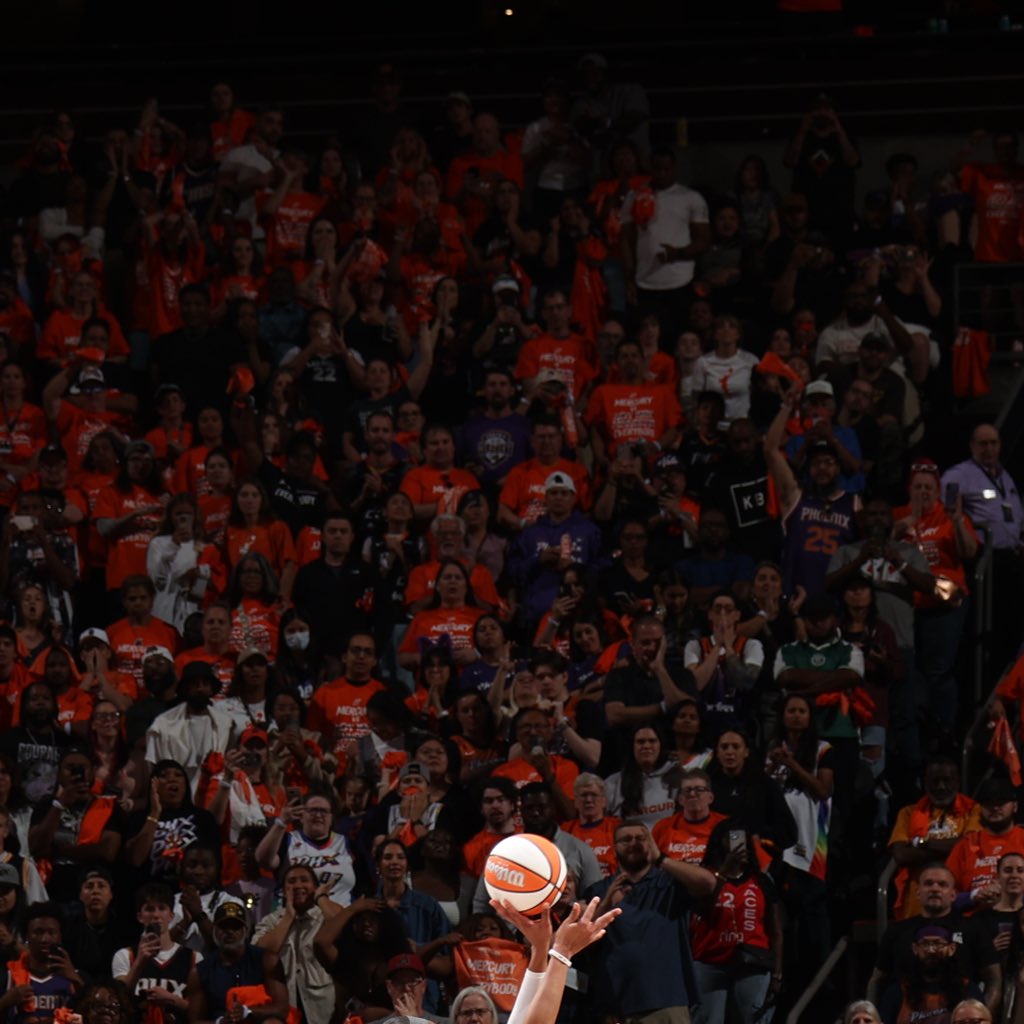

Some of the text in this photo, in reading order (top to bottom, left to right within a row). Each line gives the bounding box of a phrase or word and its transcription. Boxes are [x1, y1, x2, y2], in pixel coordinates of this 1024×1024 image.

[804, 526, 841, 554] 25
[336, 706, 367, 716] MERCU
[743, 889, 757, 931] ACES
[467, 958, 517, 976] MERCURY
